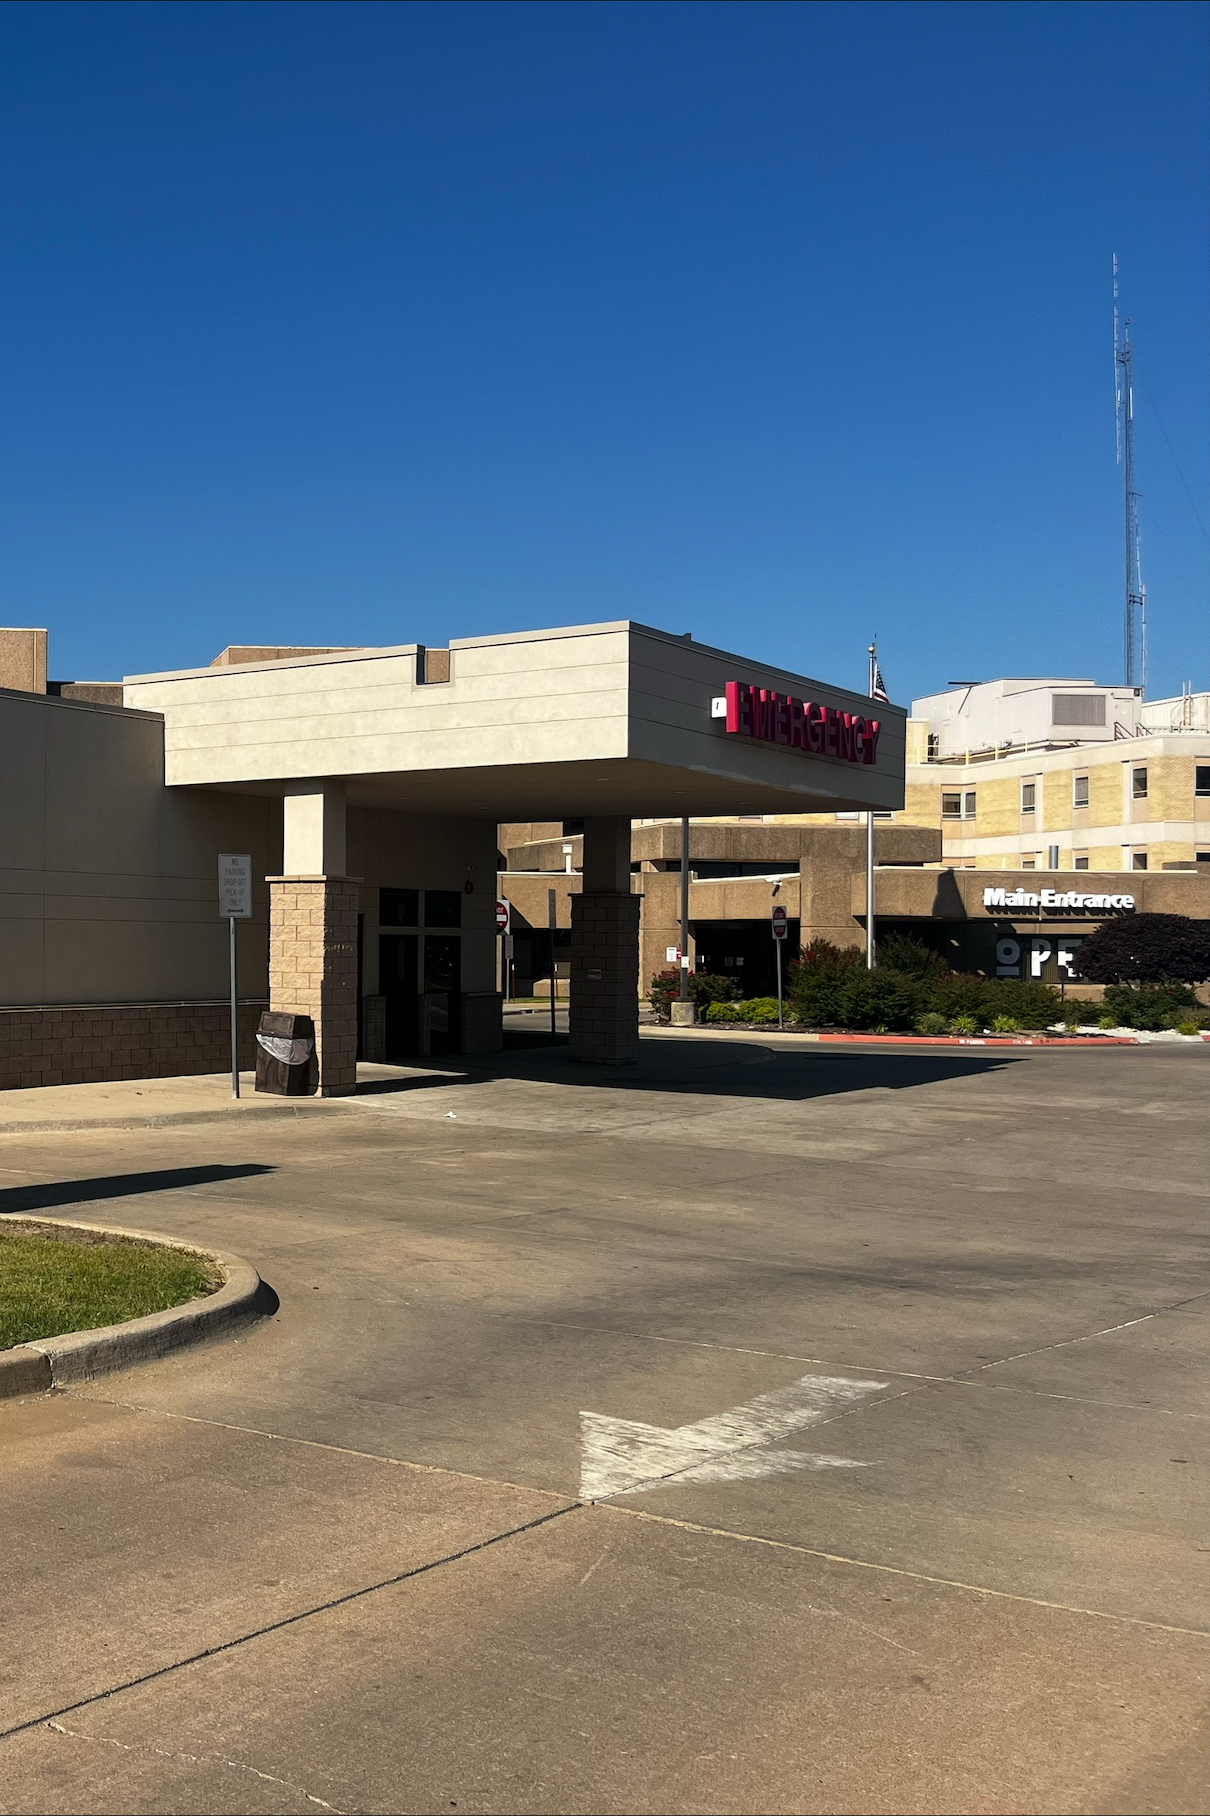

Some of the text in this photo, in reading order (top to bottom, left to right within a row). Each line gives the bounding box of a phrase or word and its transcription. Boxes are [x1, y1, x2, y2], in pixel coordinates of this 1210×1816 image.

[725, 681, 881, 765] EMERGENCY
[224, 868, 246, 876] PARKING
[229, 899, 242, 907] ONLY
[983, 888, 1135, 909] Main Entrance
[996, 938, 1083, 978] OPE
